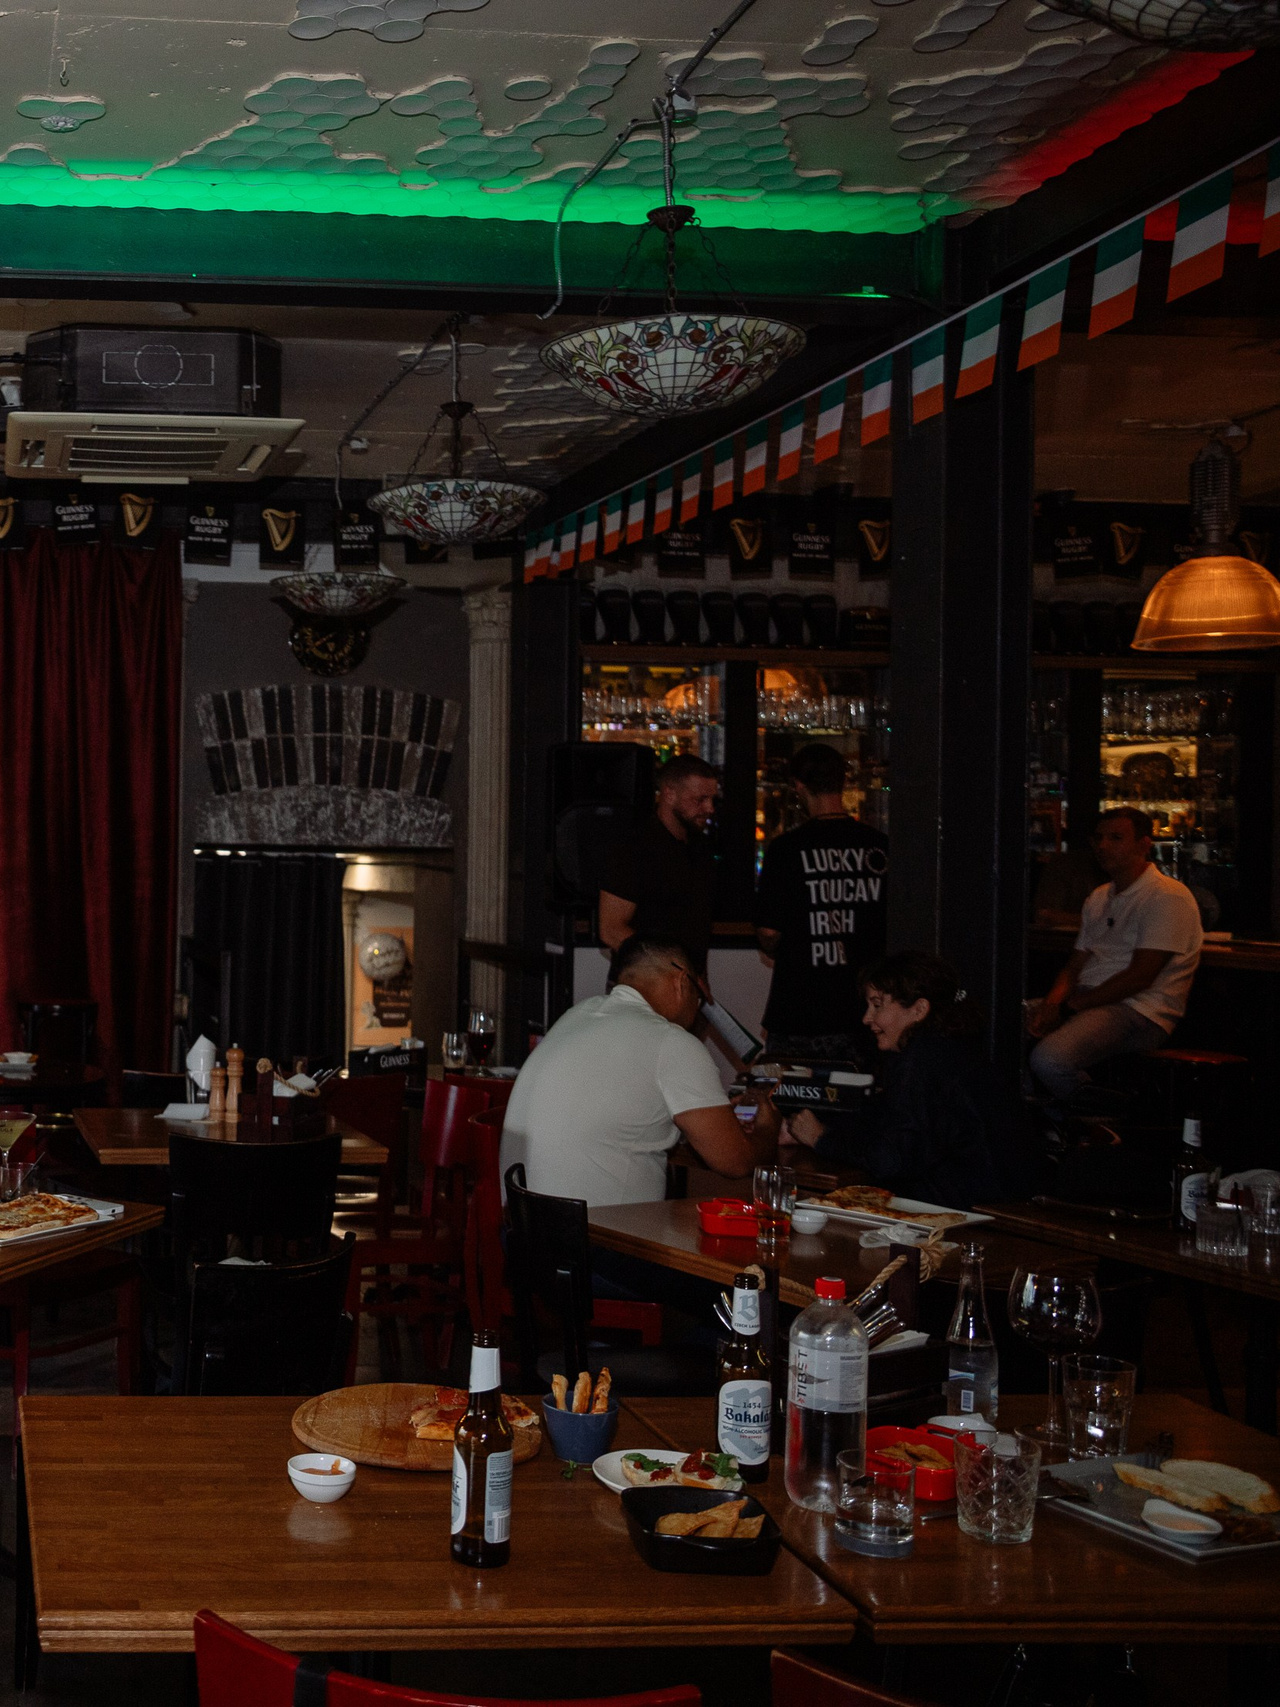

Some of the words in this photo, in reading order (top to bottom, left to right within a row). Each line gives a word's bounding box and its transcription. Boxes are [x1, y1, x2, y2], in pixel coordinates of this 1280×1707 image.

[61, 513, 89, 522] RUGBY
[189, 515, 230, 528] GUINNESS
[194, 525, 223, 535] RUGBY
[792, 532, 831, 544] GUINNESS
[800, 847, 864, 874] LUCKY
[379, 1053, 412, 1069] GUINNESS
[742, 1401, 762, 1409] 1454
